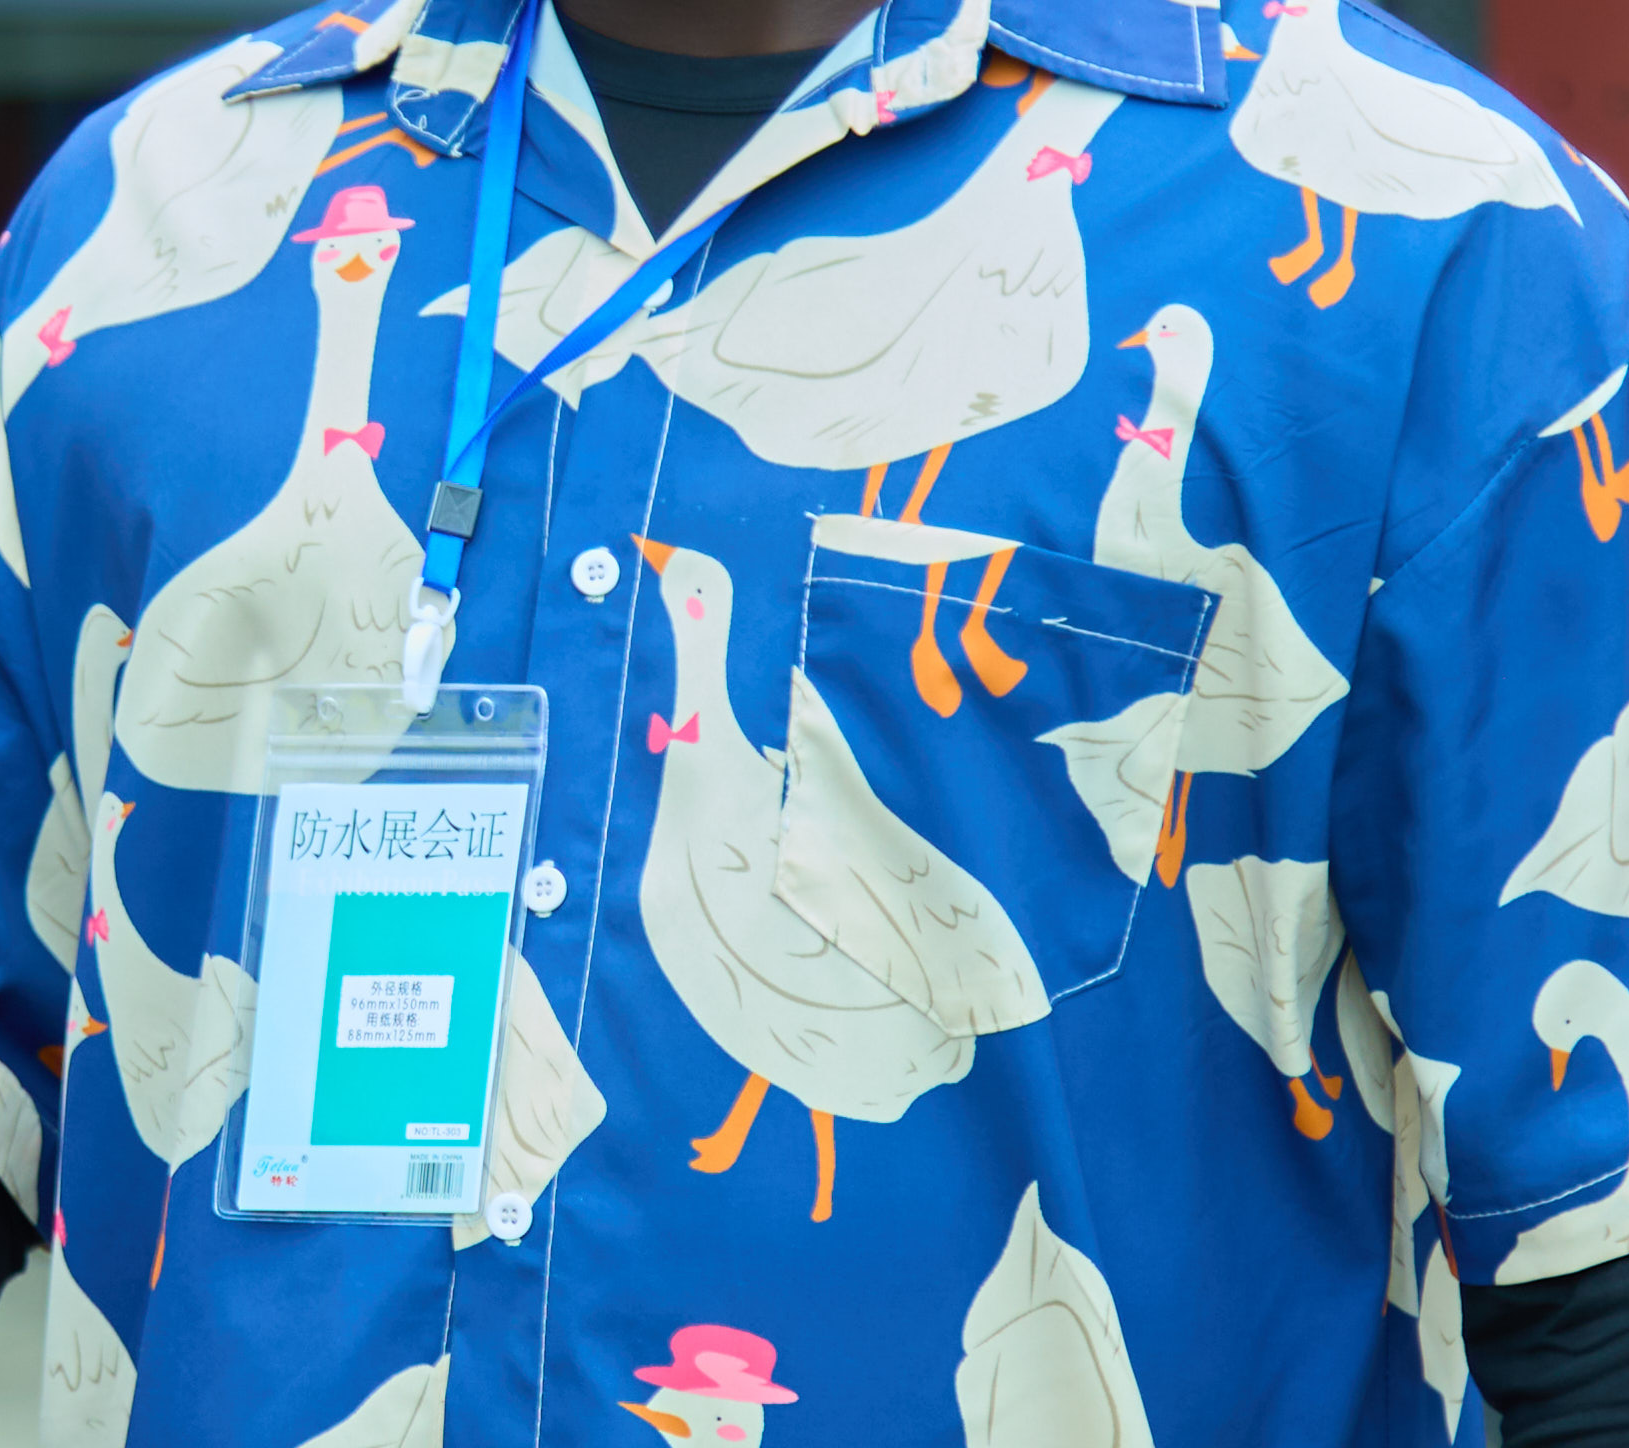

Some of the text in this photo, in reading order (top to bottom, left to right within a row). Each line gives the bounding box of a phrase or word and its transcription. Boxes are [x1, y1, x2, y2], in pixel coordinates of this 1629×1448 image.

[291, 808, 509, 860] 防水展会证
[298, 868, 496, 897] Exhibition Pass
[350, 998, 440, 1011] 96mmx150mm
[347, 1029, 437, 1042] 88mmx125mm
[410, 1153, 429, 1161] MADE
[441, 1153, 463, 1161] CHINA
